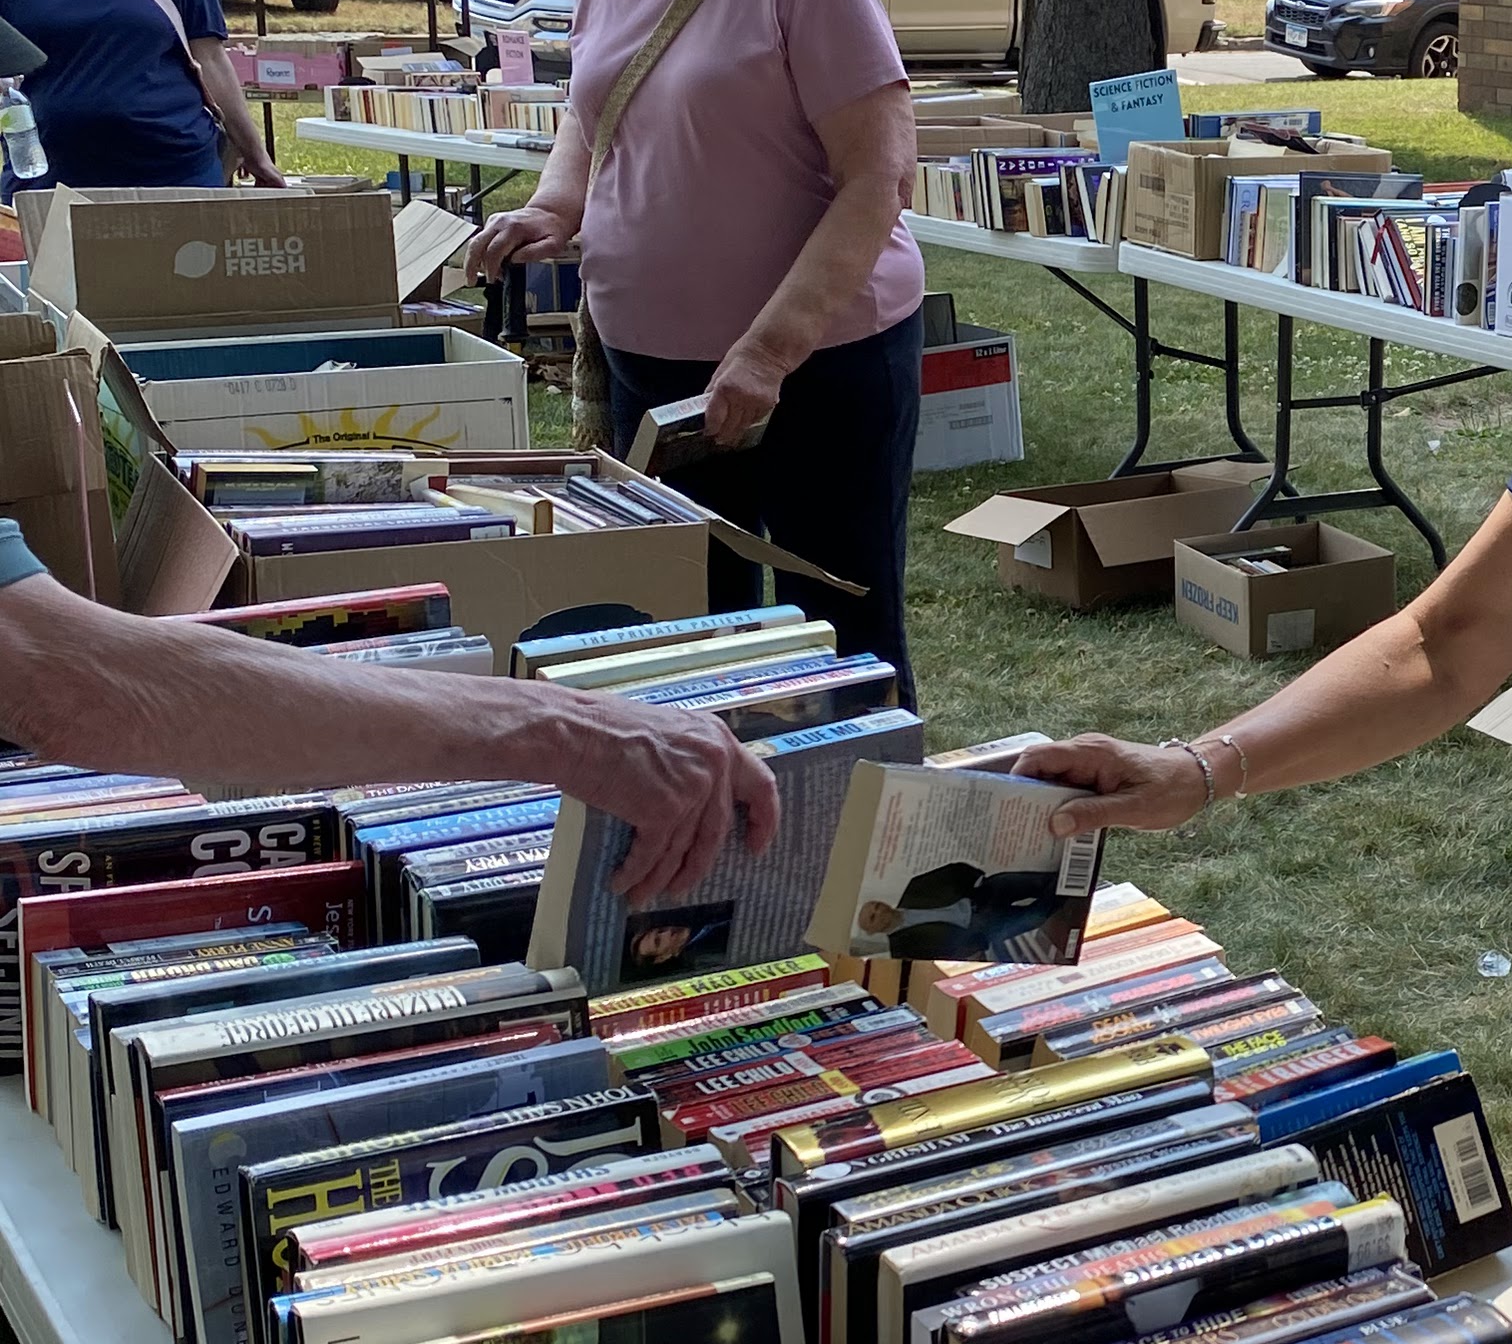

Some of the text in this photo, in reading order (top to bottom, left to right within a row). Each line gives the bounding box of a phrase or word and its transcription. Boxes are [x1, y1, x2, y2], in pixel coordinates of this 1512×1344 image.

[1093, 74, 1174, 98] SCIENCE FICTION
[1111, 93, 1164, 112] & FANTASY
[225, 235, 304, 257] HELLO
[225, 256, 306, 277] FRESH
[1180, 577, 1240, 625] KEEP FROZEN
[580, 612, 755, 647] THE PRIVATE PATIENT
[785, 728, 827, 749] BLUE
[744, 959, 801, 985] RIVER
[687, 1010, 824, 1057] John Sandford
[1222, 1029, 1284, 1056] THE FACE
[684, 1039, 780, 1073] LEE CHILD
[695, 1061, 795, 1096] LEE CHILD
[212, 1166, 241, 1269] EDWARD
[849, 1179, 1034, 1236] AMANDA QUICK
[980, 1248, 1080, 1292] SUSPECT
[1194, 1306, 1247, 1334] HIDE
